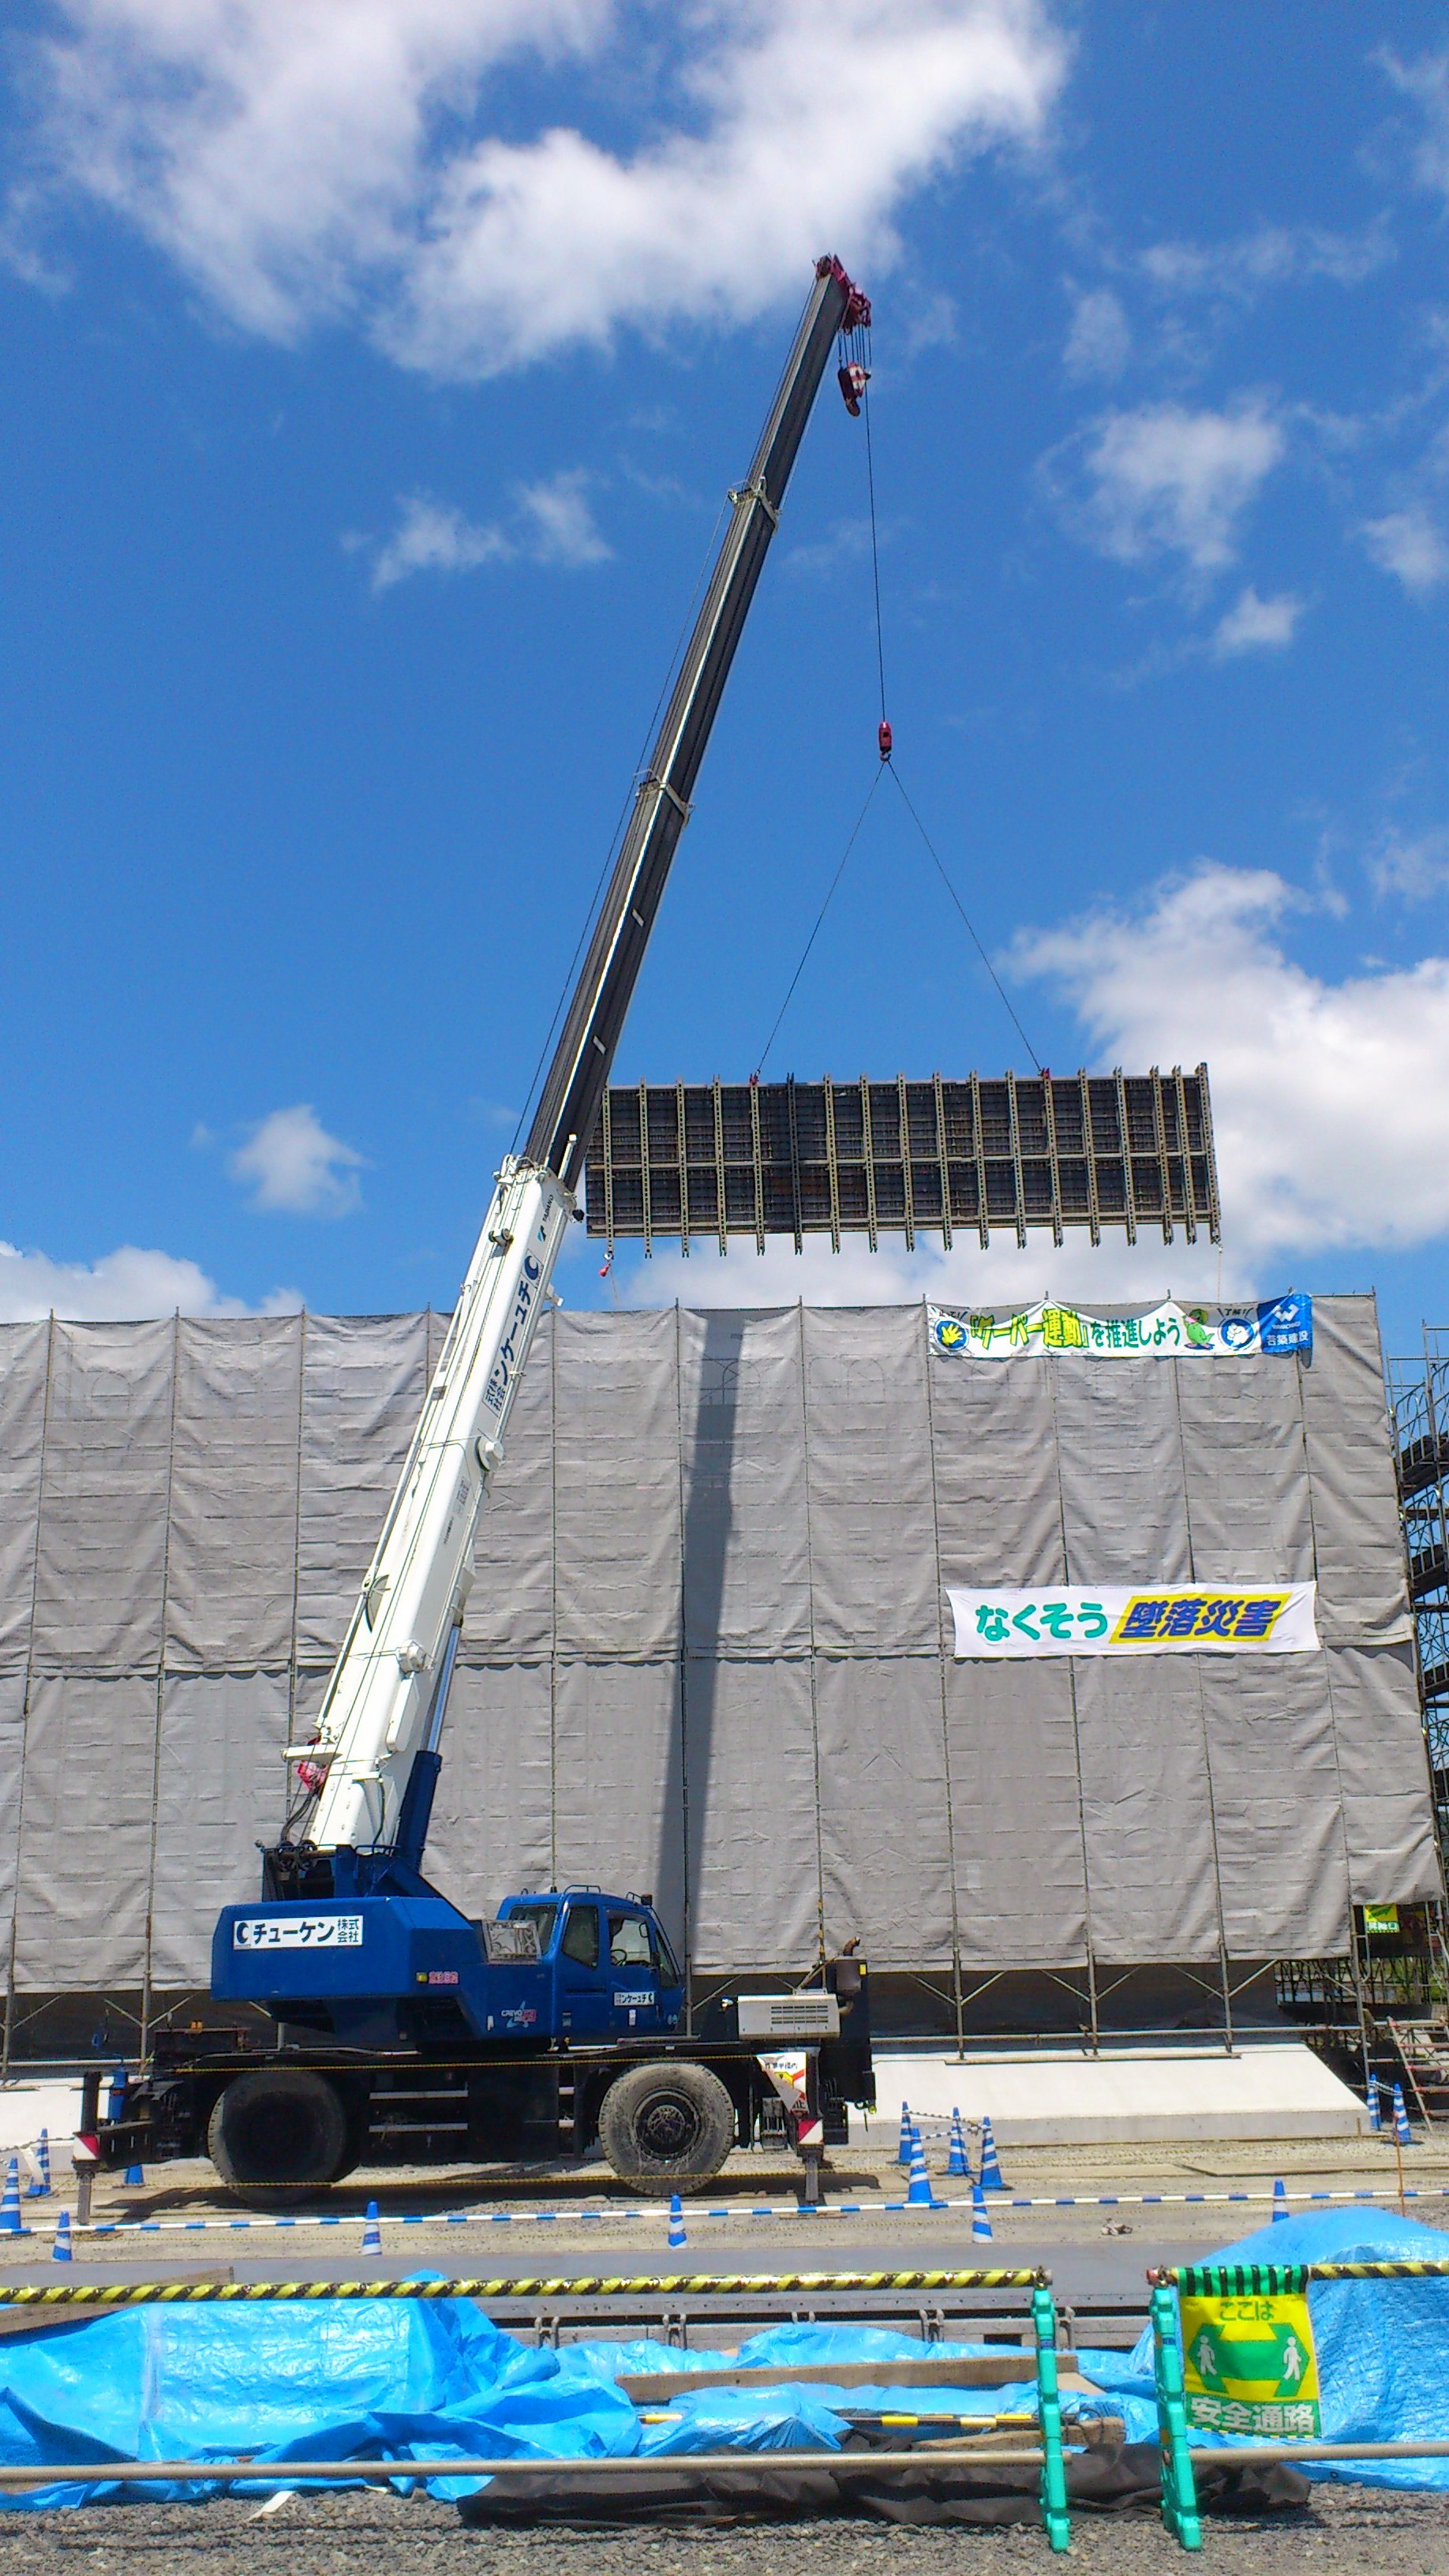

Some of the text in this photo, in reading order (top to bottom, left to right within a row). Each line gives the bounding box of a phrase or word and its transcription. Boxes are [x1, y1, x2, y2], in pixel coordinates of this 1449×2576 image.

[975, 1599, 1281, 1642] なくそう 墜落災害
[253, 1922, 335, 1945] チューケン
[1219, 2301, 1275, 2322] ここは
[1190, 2398, 1315, 2433] 安全通路
